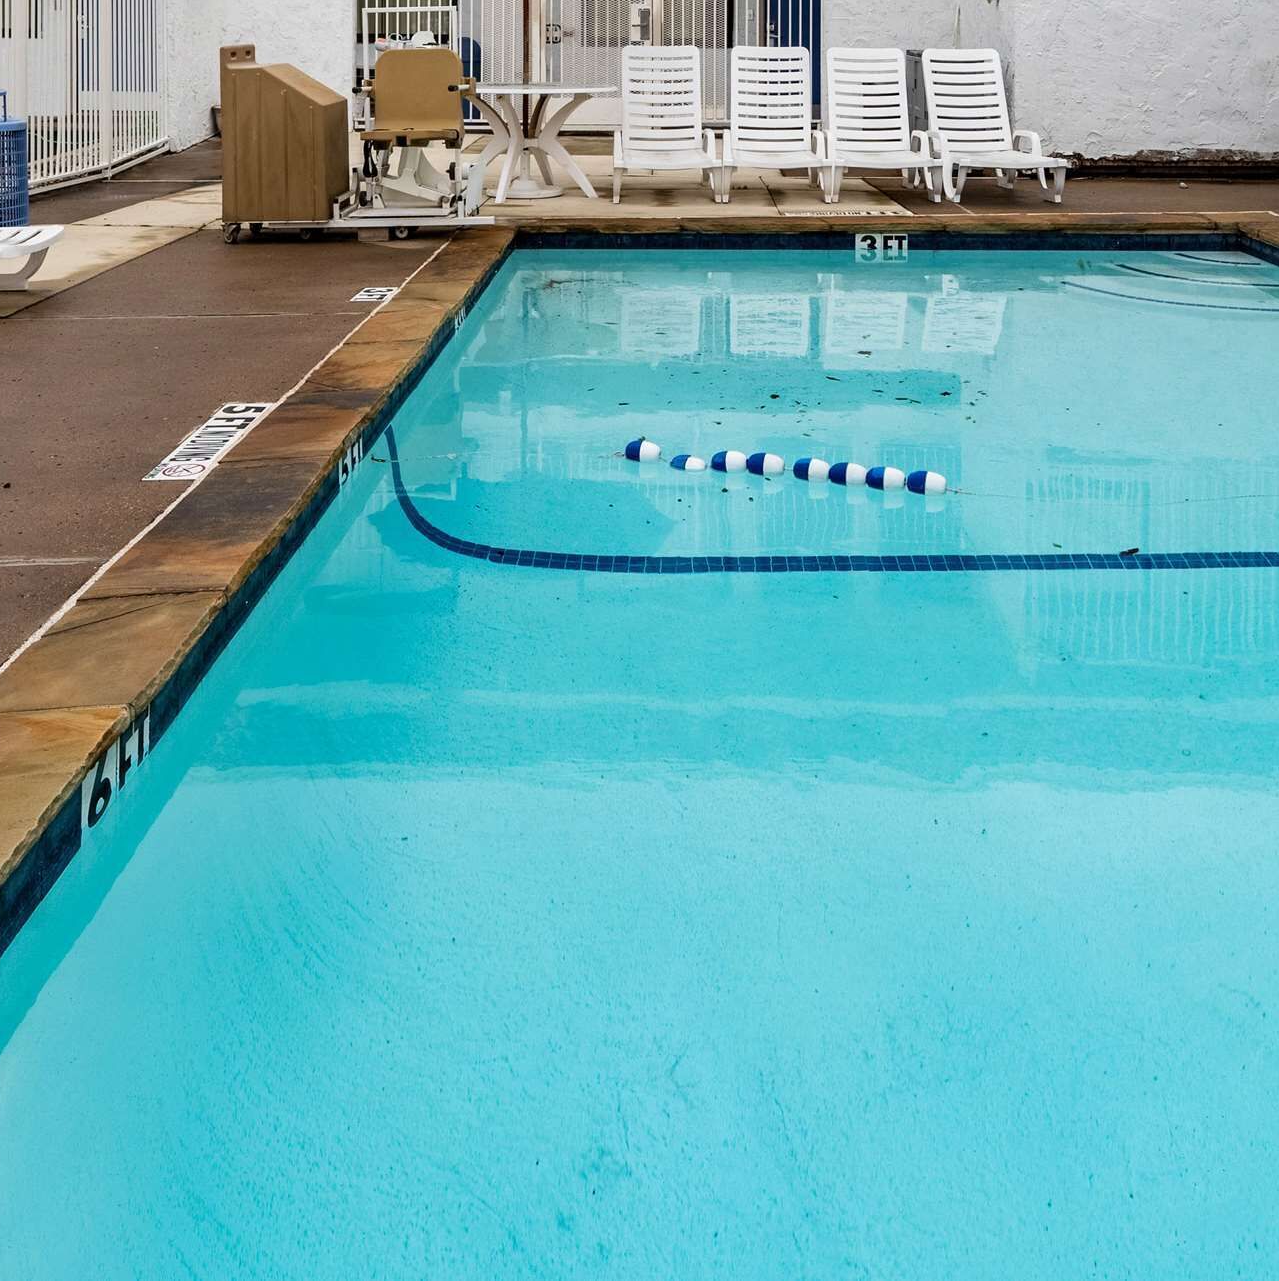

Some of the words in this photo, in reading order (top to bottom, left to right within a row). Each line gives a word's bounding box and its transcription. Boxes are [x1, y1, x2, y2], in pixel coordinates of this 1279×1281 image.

[860, 235, 877, 250] 3
[219, 405, 268, 413] 5
[88, 750, 112, 828] 6
